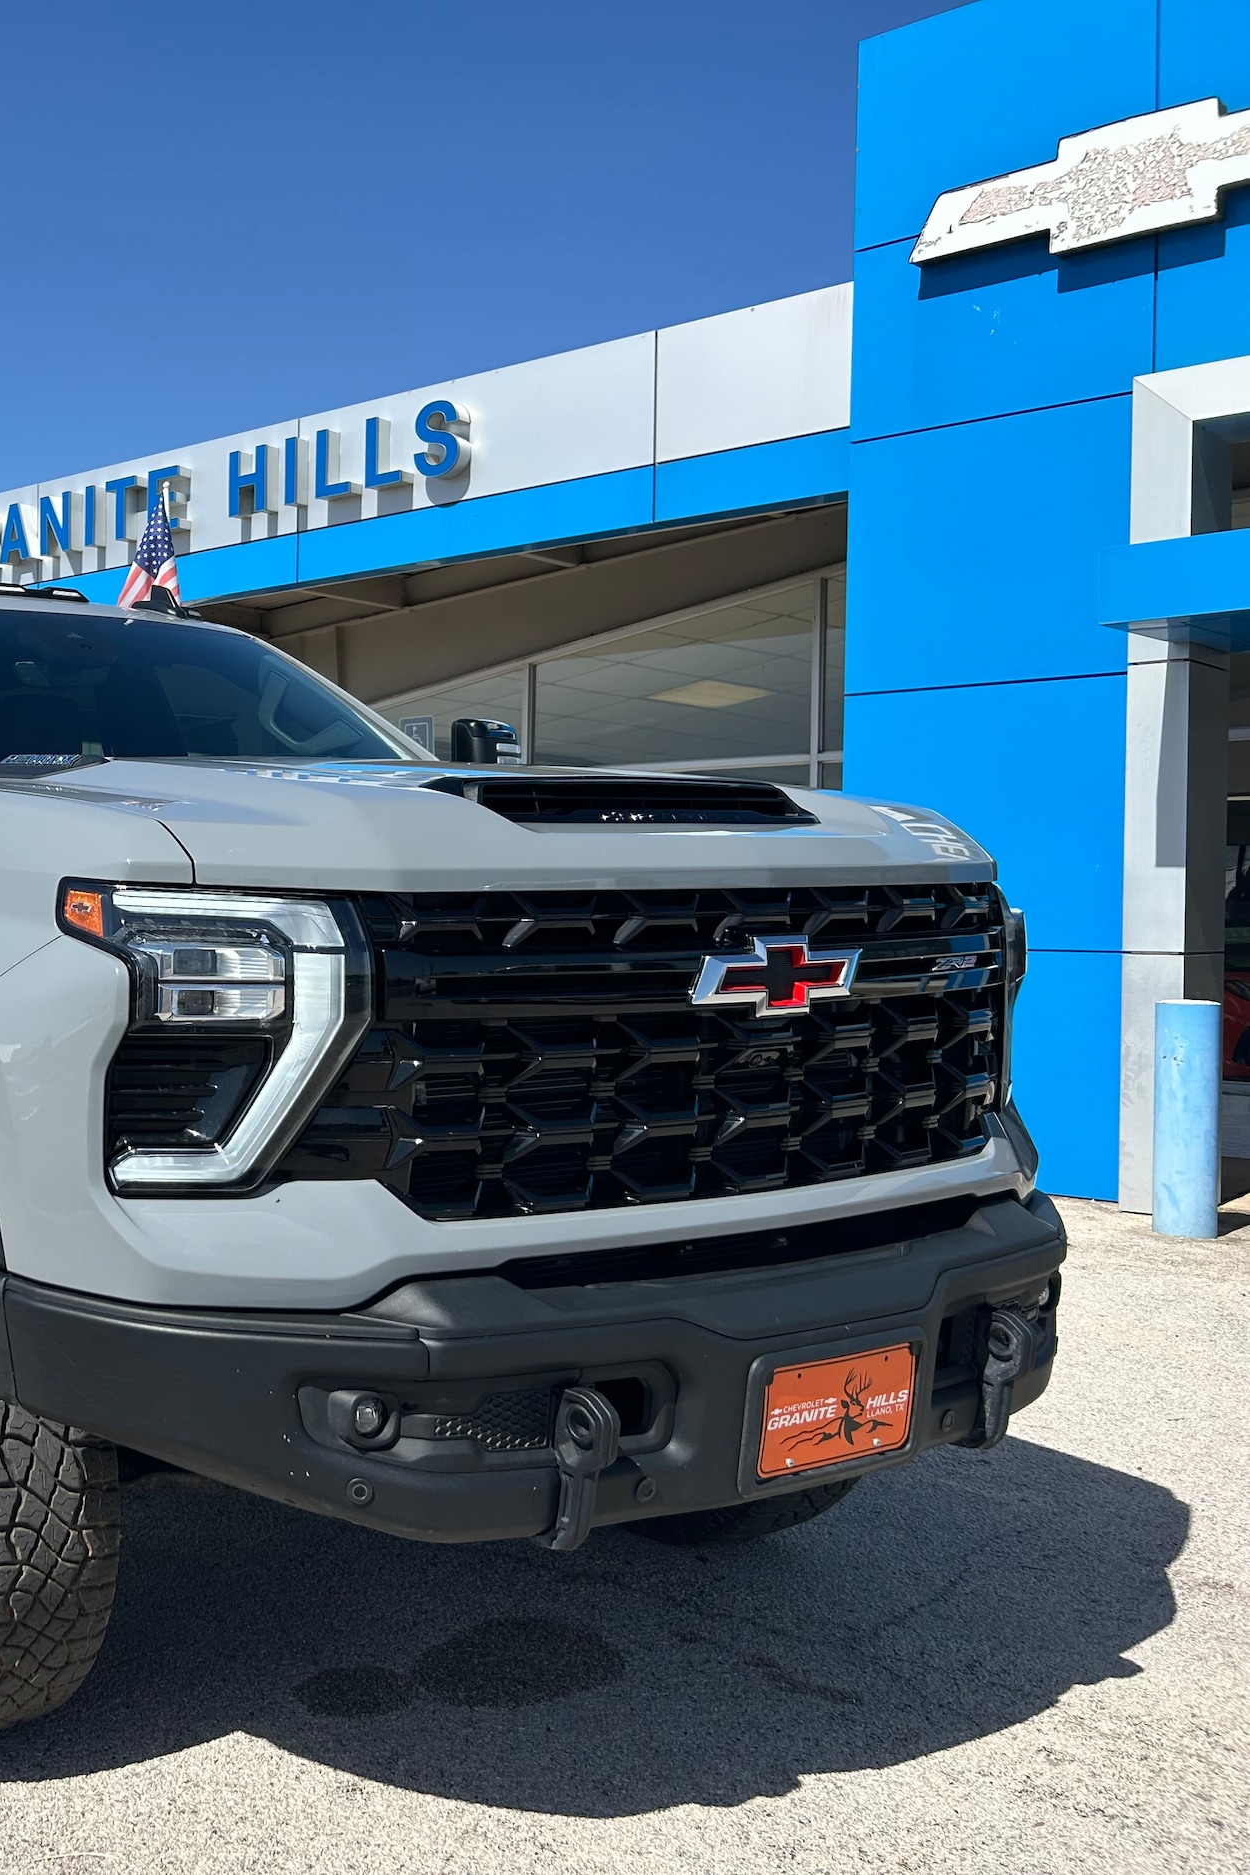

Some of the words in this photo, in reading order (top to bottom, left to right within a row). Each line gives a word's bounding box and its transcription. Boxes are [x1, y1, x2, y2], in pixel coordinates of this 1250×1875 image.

[228, 400, 462, 518] HILLS
[931, 955, 978, 971] ZR2
[767, 1404, 838, 1431] GRANITE
[865, 1389, 909, 1410] HILLS
[783, 1398, 825, 1414] CHEVROLET
[866, 1405, 893, 1419] LLANO,
[895, 1402, 905, 1413] TX
